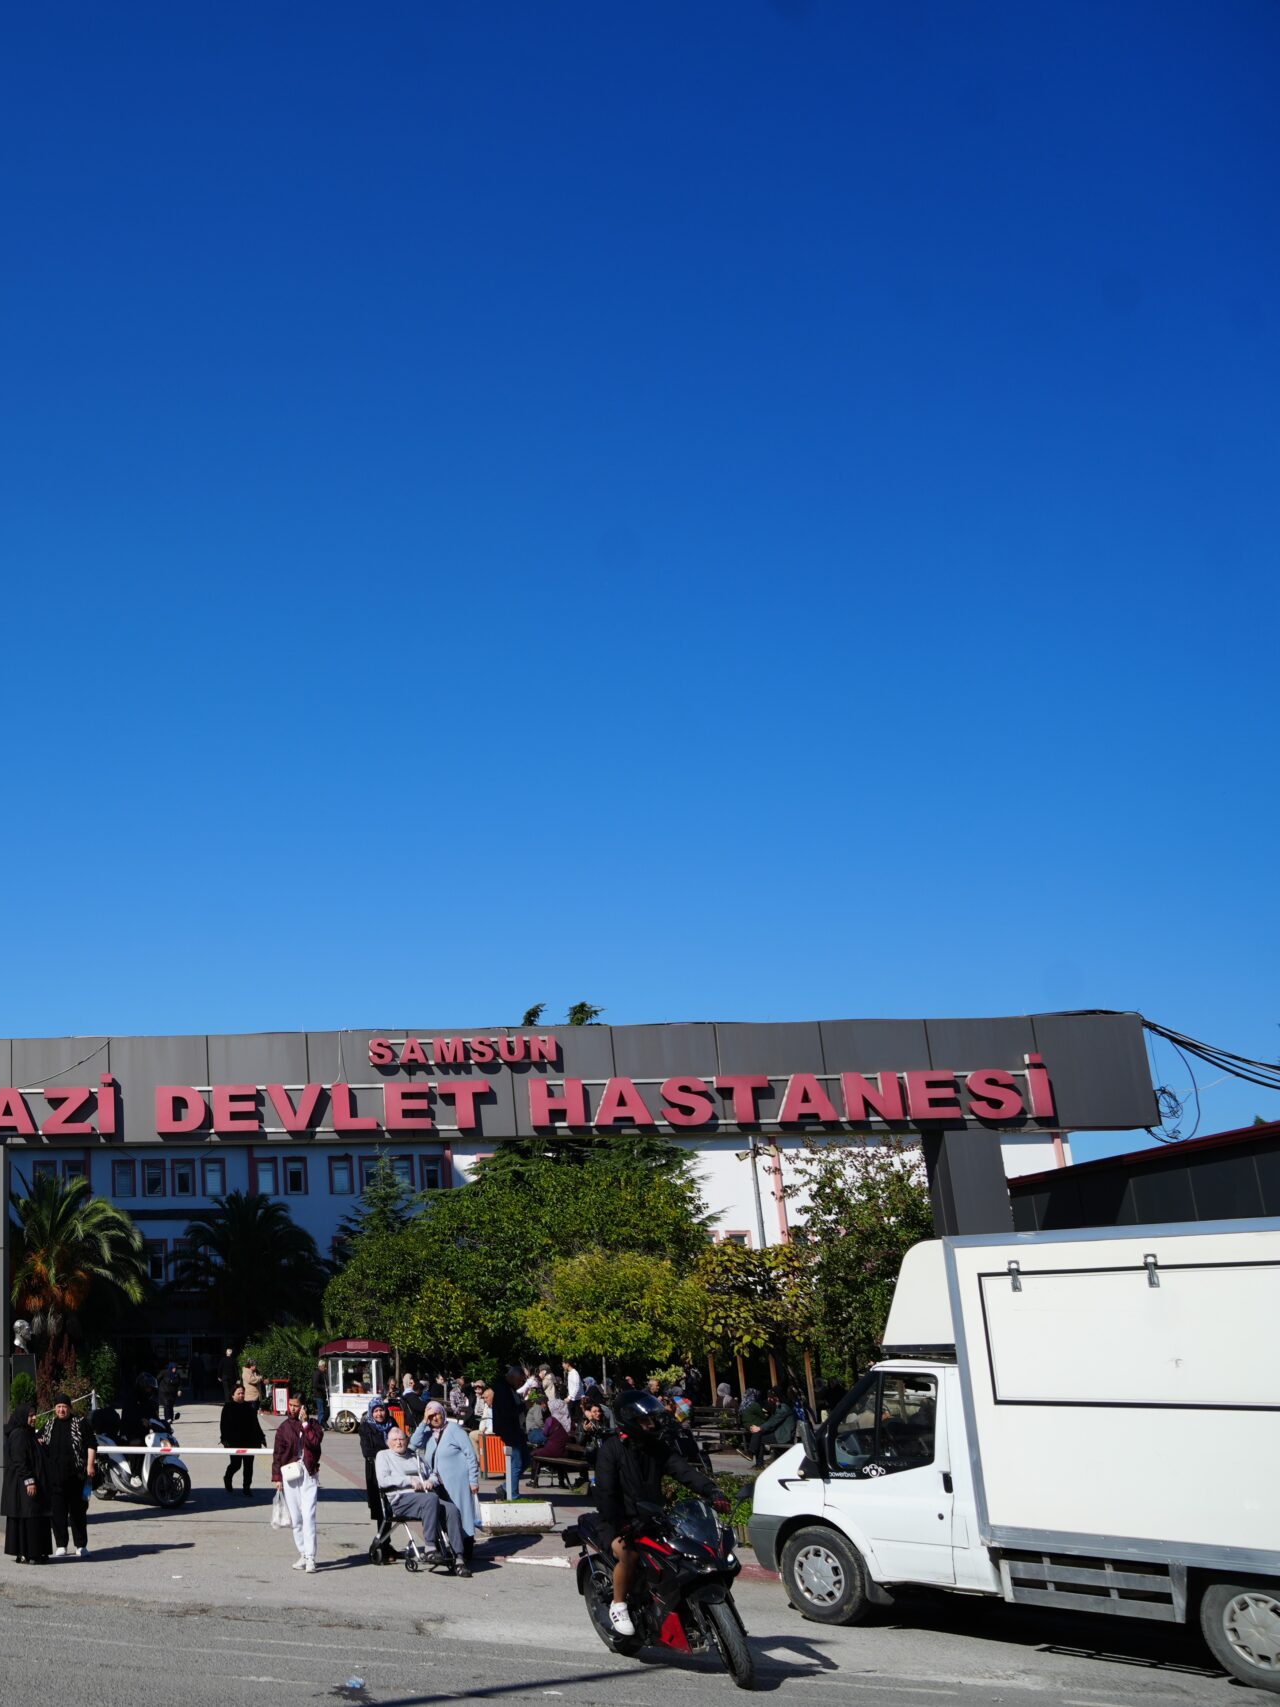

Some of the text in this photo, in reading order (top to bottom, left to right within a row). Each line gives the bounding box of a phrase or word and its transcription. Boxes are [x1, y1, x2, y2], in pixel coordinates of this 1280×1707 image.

[369, 1035, 557, 1066] SAMSUN
[156, 1079, 490, 1134] DEVLET
[528, 1053, 1055, 1128] HASTANESİ
